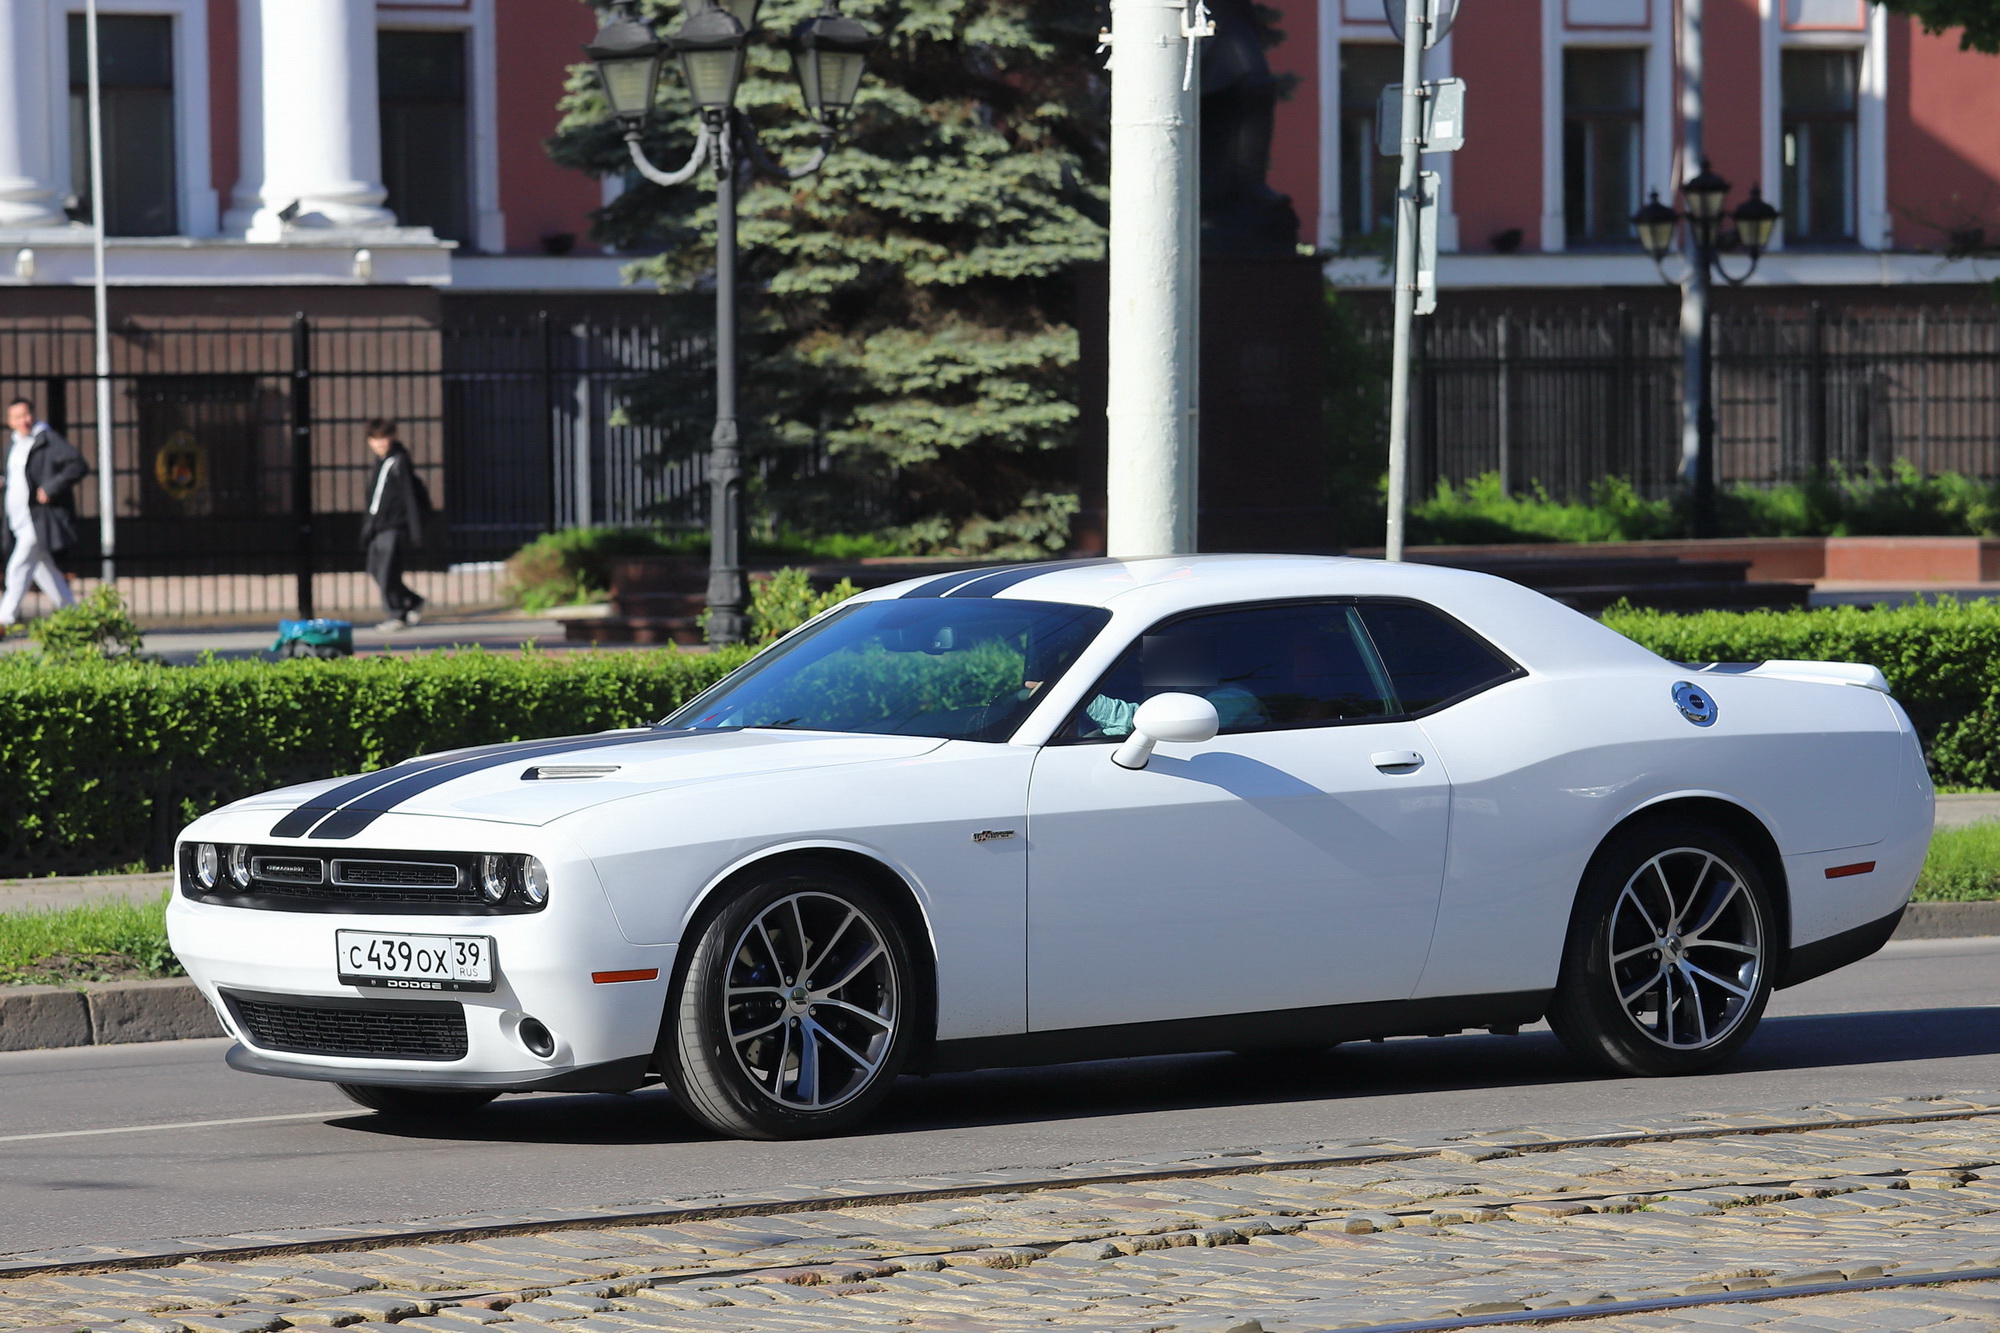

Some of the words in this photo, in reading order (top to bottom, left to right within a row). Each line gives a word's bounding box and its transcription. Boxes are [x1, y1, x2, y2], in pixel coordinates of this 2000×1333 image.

[455, 942, 480, 966] 39
[459, 967, 479, 977] RUS
[387, 980, 442, 990] DODGE
